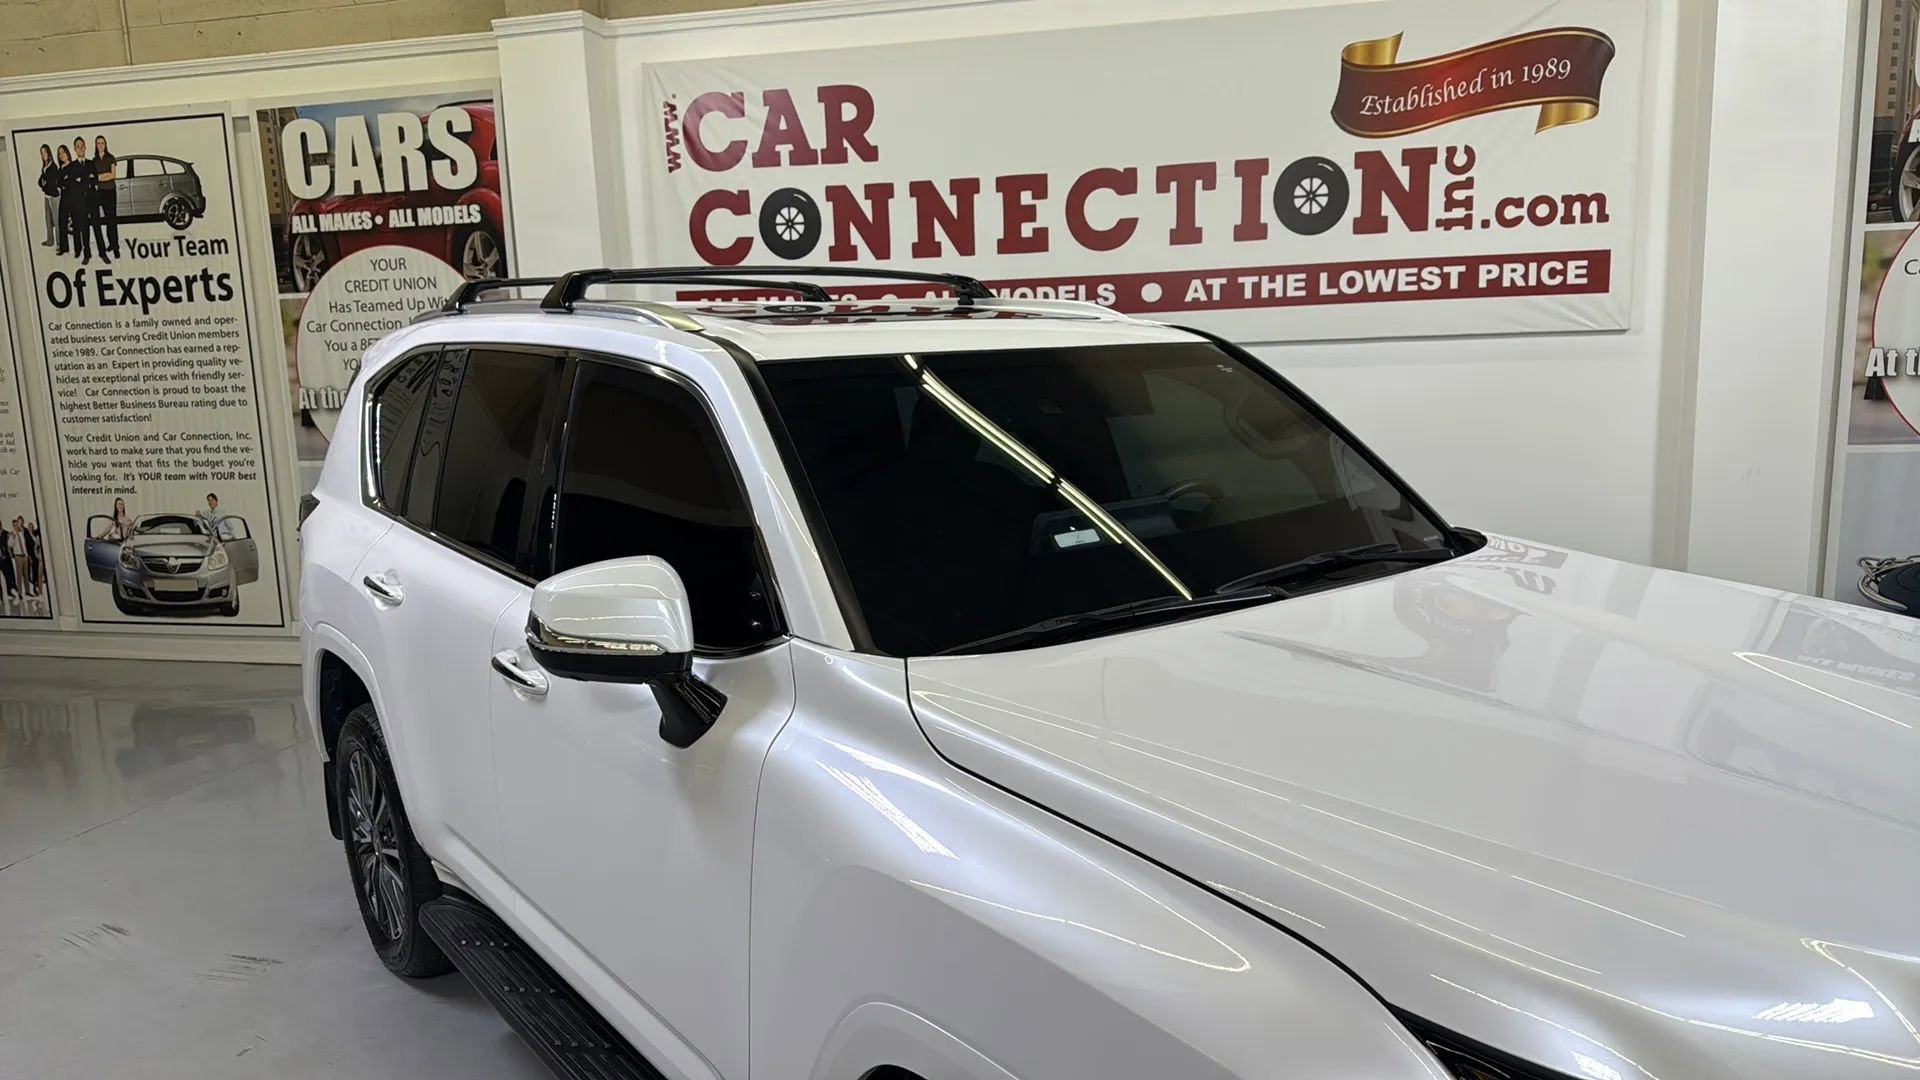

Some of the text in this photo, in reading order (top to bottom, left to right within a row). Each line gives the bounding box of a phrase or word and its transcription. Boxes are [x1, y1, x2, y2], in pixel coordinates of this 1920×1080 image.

[1360, 57, 1571, 115] Established in 1989
[682, 84, 879, 172] CAR
[281, 106, 477, 200] CARS
[1481, 193, 1610, 228] .com
[292, 204, 481, 233] ALL MAKES ALL MODELS
[124, 235, 230, 259] Your Team
[370, 257, 407, 271] YOUR
[344, 276, 437, 293] CREDIT UNION
[1184, 278, 1227, 302] AT
[1238, 273, 1307, 299] THE
[1319, 265, 1466, 295] LOWEST
[1478, 260, 1588, 289] PRICE
[46, 267, 234, 315] Of Experts
[329, 301, 352, 313] Has
[353, 298, 403, 312] Teamed
[407, 297, 426, 312] Up
[48, 322, 62, 331] Car
[65, 320, 113, 330] Connection
[115, 320, 122, 329] is
[133, 318, 159, 329] family
[161, 315, 191, 326] owned
[194, 315, 211, 325] and
[214, 317, 238, 326] oper-
[306, 321, 327, 333] Car
[50, 329, 239, 344] ated business serving Credit Union members
[52, 349, 74, 358] since
[75, 348, 98, 357] 1989.
[100, 347, 115, 356] Car
[116, 345, 166, 356] Connection
[167, 345, 182, 354] has
[183, 343, 214, 353] earned
[223, 344, 241, 354] rep-
[324, 339, 348, 352] You
[351, 341, 358, 351] a
[54, 362, 85, 371] utation
[111, 360, 140, 370] Expert
[141, 360, 150, 368] in
[152, 358, 194, 370] providing
[196, 356, 227, 368] quality
[228, 358, 243, 366] ve-
[1864, 347, 1898, 377] At
[55, 370, 245, 385] hicles at exceptional prices with friendly ser-
[57, 384, 246, 397] vice! Car Connection is proud to boast the
[299, 387, 318, 409] At
[60, 397, 248, 413] highest Better Business Bureau rating due to
[61, 412, 152, 423] customer satisfaction!
[64, 431, 252, 442] Your Credit Union and Car Connection, Inc.
[66, 447, 87, 455] work
[88, 446, 108, 455] hard
[110, 447, 119, 455] to
[120, 446, 143, 455] make
[165, 445, 183, 454] that
[184, 447, 202, 456] you
[203, 444, 221, 454] find
[222, 444, 238, 453] the
[68, 460, 88, 468] hicle
[91, 461, 107, 470] you
[135, 459, 153, 468] that
[156, 458, 170, 468] fits
[174, 458, 188, 467] the
[192, 457, 224, 469] budget
[228, 458, 255, 469] you're
[70, 471, 256, 483] looking for. It's YOUR team with YOUR best
[72, 485, 137, 495] interest in mind.
